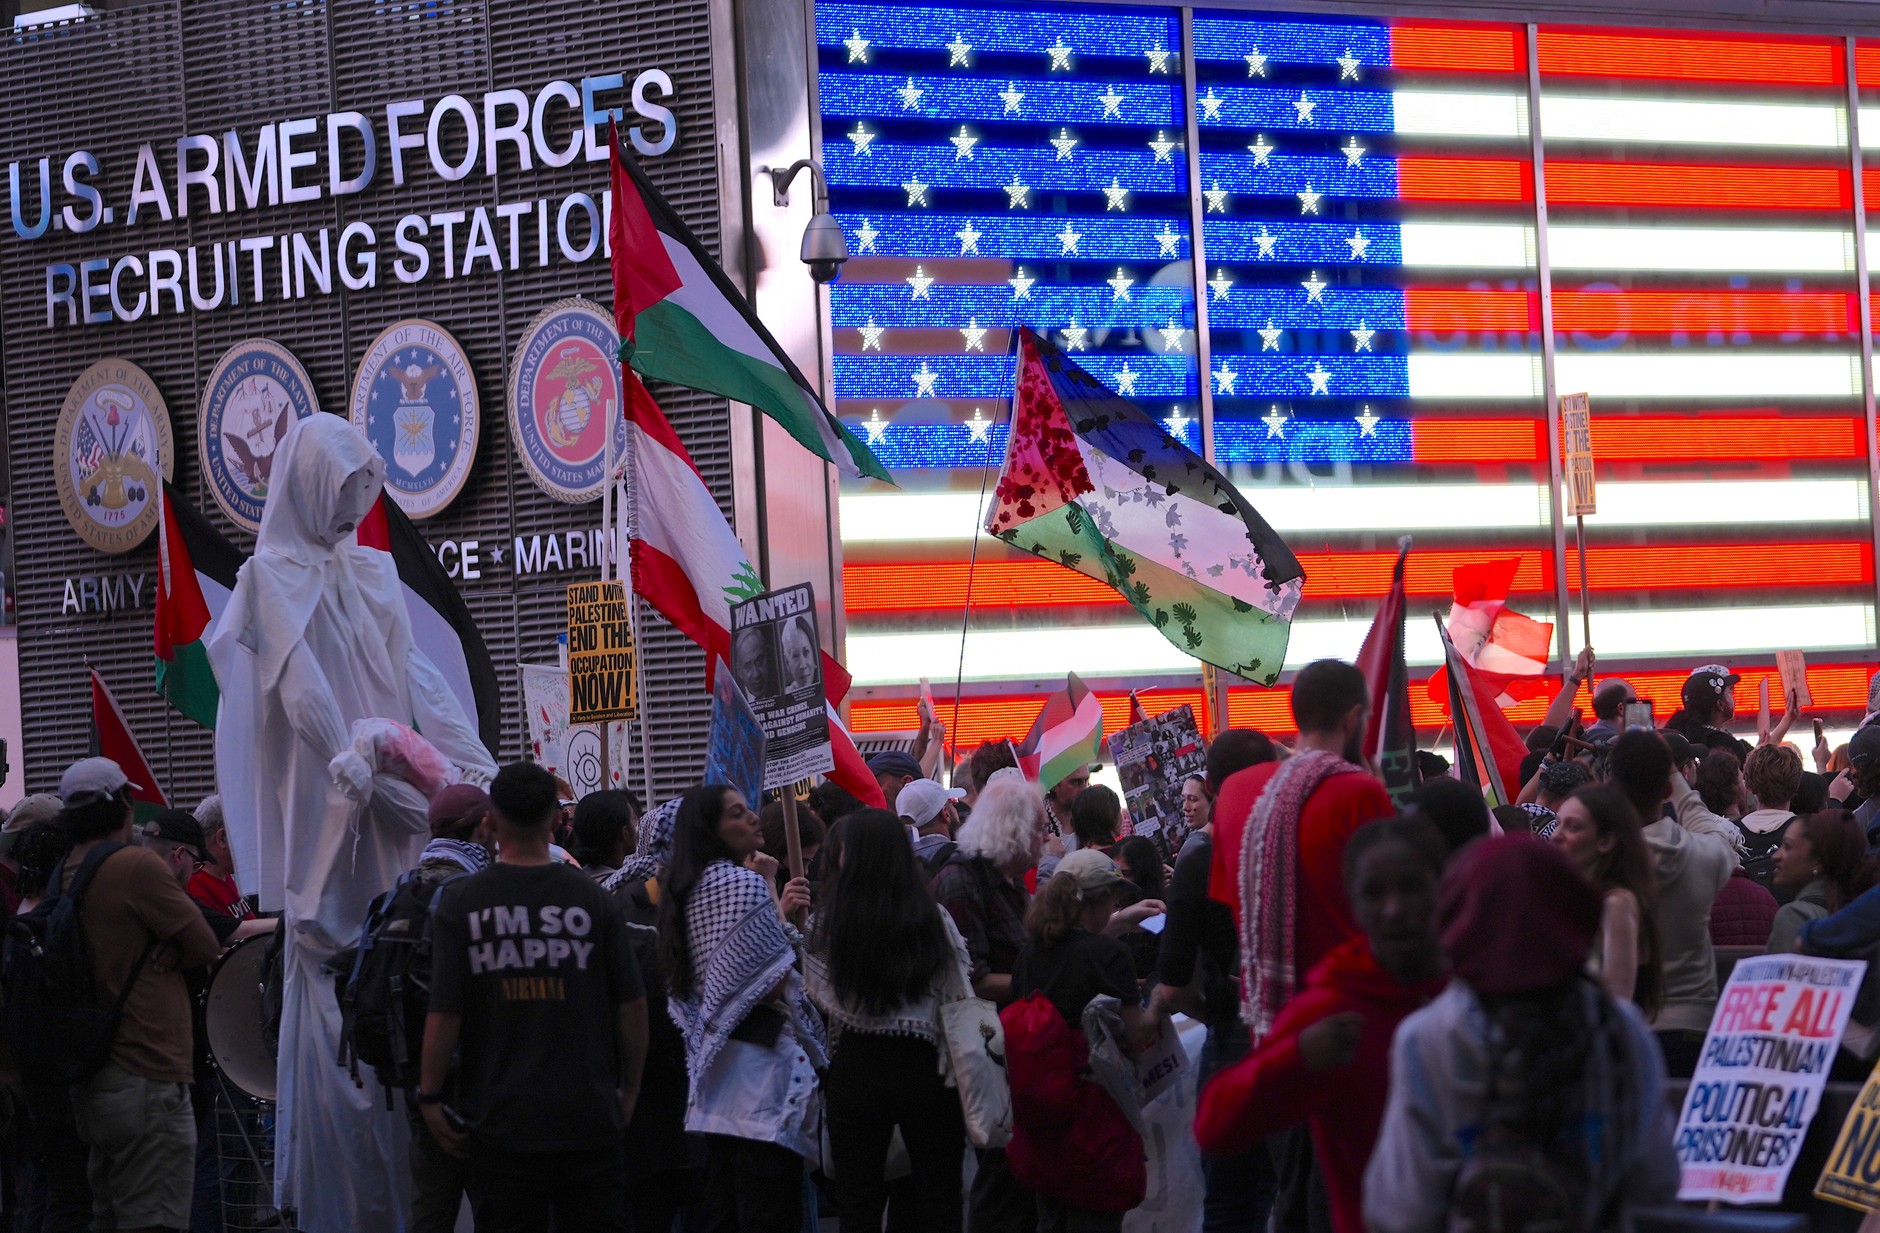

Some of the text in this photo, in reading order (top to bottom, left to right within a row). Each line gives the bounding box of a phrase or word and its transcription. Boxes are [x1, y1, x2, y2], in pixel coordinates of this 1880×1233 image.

[10, 68, 677, 240] U.S. ARMED FORCES
[46, 220, 377, 328] RECRUITING
[520, 318, 569, 408] DEPARTMENT
[572, 319, 584, 330] OF
[586, 321, 605, 340] THE
[60, 368, 169, 447] DEPARTMENT OF THE ARMY
[210, 358, 309, 438] DEPARTMENT OF THE NAVY
[394, 328, 411, 344] OF
[419, 328, 445, 351] THE
[447, 353, 466, 381] AIR
[462, 390, 474, 452] FORCE
[525, 423, 551, 468] UNITED
[551, 466, 583, 482] STATES
[1573, 430, 1590, 452] THE
[59, 463, 81, 520] UNITED
[83, 521, 122, 545] STATES
[126, 528, 138, 541] OF
[212, 456, 265, 518] UNITED STAT
[421, 497, 432, 506] OF
[436, 467, 463, 500] AMERICA
[104, 510, 126, 522] 1775
[515, 528, 631, 575] MARIN
[62, 573, 145, 615] ARMY
[569, 583, 624, 605] STAND WITH
[569, 601, 628, 625] PALESTINE!
[735, 587, 810, 630] WANTED
[570, 621, 632, 653] END THE
[570, 652, 633, 675] OCCUPATION
[572, 670, 631, 712] NOW!
[762, 716, 794, 730] AGAINST
[767, 709, 785, 719] WAR
[777, 721, 807, 737] GENOCIDE
[766, 760, 779, 768] STOP
[468, 905, 592, 941] I'M SO
[468, 938, 595, 975] HAPPY
[1714, 983, 1843, 1038] FREE ALL
[1700, 1034, 1831, 1074] PALESTINIAN
[1684, 1081, 1811, 1130] POLITICAL
[1675, 1126, 1799, 1168] PRISONERS
